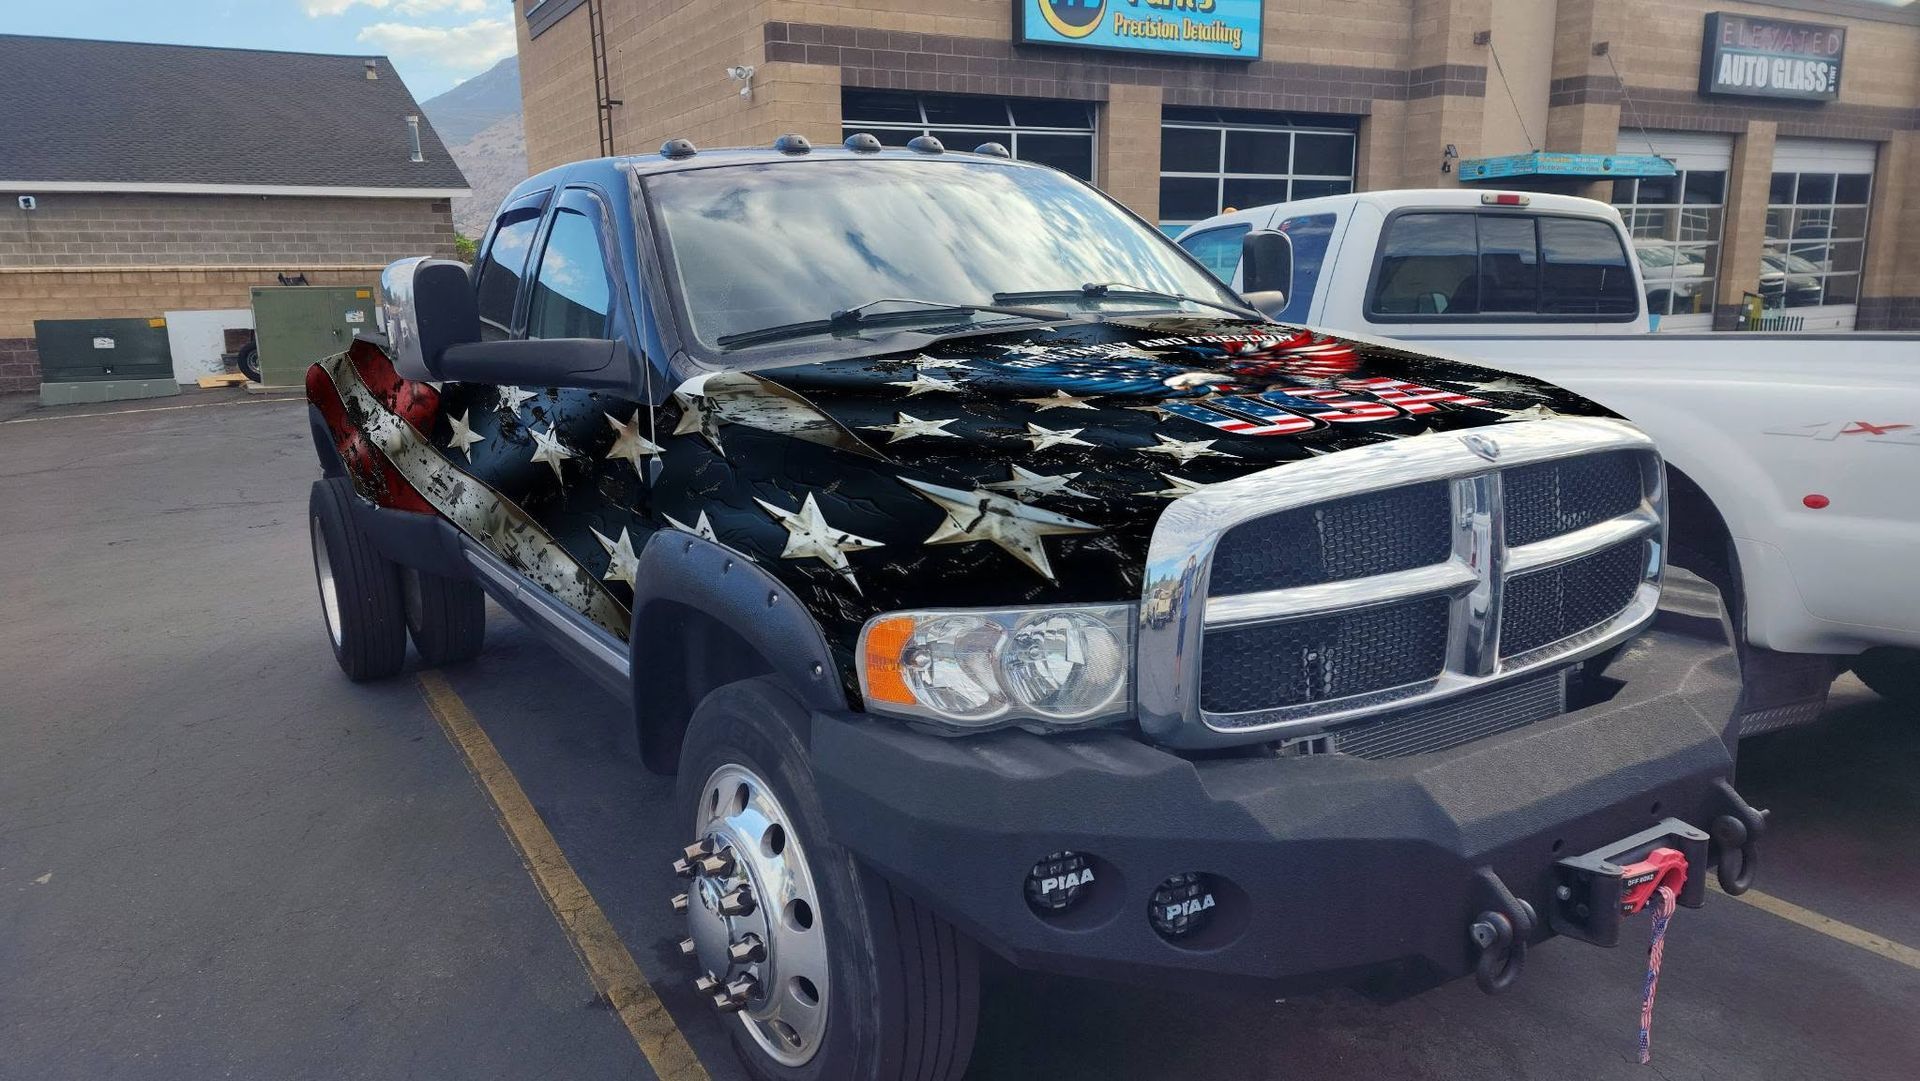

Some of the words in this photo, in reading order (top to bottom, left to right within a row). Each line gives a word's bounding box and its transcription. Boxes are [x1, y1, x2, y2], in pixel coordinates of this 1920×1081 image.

[1113, 12, 1180, 40] Precision
[1182, 17, 1242, 50] Detailing
[1723, 22, 1840, 55] ELEVATED
[1718, 54, 1768, 88] AUTO
[1771, 58, 1828, 92] GLASS
[1137, 337, 1189, 348] AND
[1186, 335, 1295, 344] FREEDOM
[1157, 377, 1495, 437] USA
[1041, 868, 1094, 895] PIAA
[1166, 894, 1216, 921] PIAA
